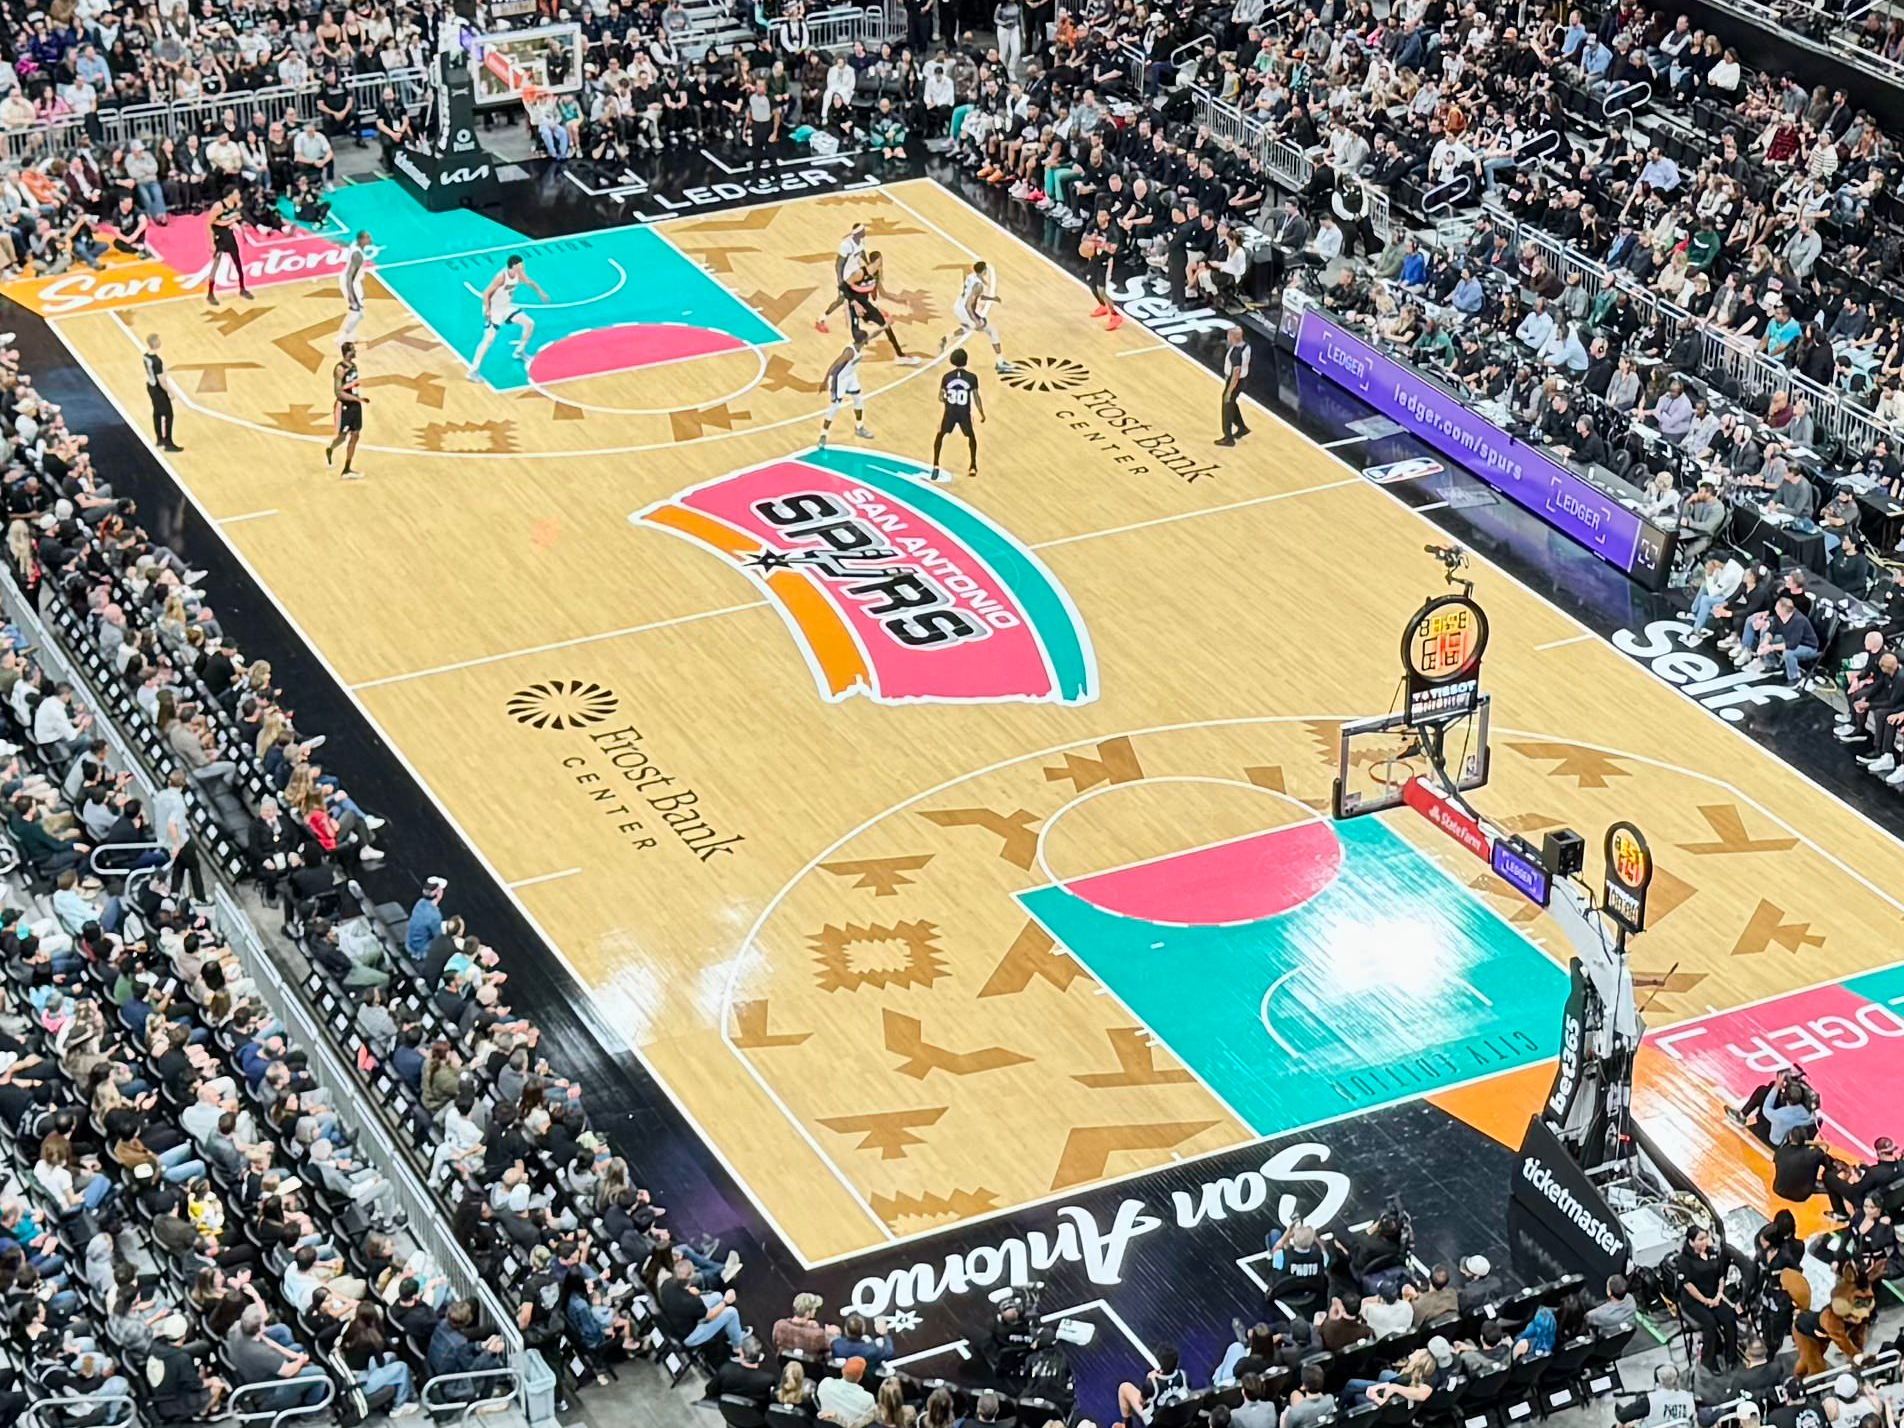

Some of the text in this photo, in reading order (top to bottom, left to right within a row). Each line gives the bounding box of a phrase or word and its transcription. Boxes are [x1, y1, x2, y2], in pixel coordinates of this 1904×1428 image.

[652, 168, 841, 212] LEDGER
[37, 243, 388, 314] San Antono
[945, 387, 968, 406] 30
[1325, 341, 1366, 384] LEDGER
[1054, 409, 1151, 479] CENTER
[1071, 387, 1223, 485] Frost Bank
[1393, 382, 1524, 483] ledger.com/spurs
[1554, 489, 1601, 532] LEDGER
[751, 490, 994, 652] SPURS
[839, 485, 1021, 632] SAN ANTONIO
[562, 755, 657, 851] CENTER
[589, 724, 746, 863] Frost Bank
[1504, 858, 1534, 886] LEDGER
[1465, 1030, 1539, 1066] CITY
[1549, 1014, 1581, 1116] bet365
[840, 1141, 1352, 1320] San Antonio
[1522, 1156, 1625, 1257] ticketmaster
[1290, 1262, 1320, 1277] PHOTO
